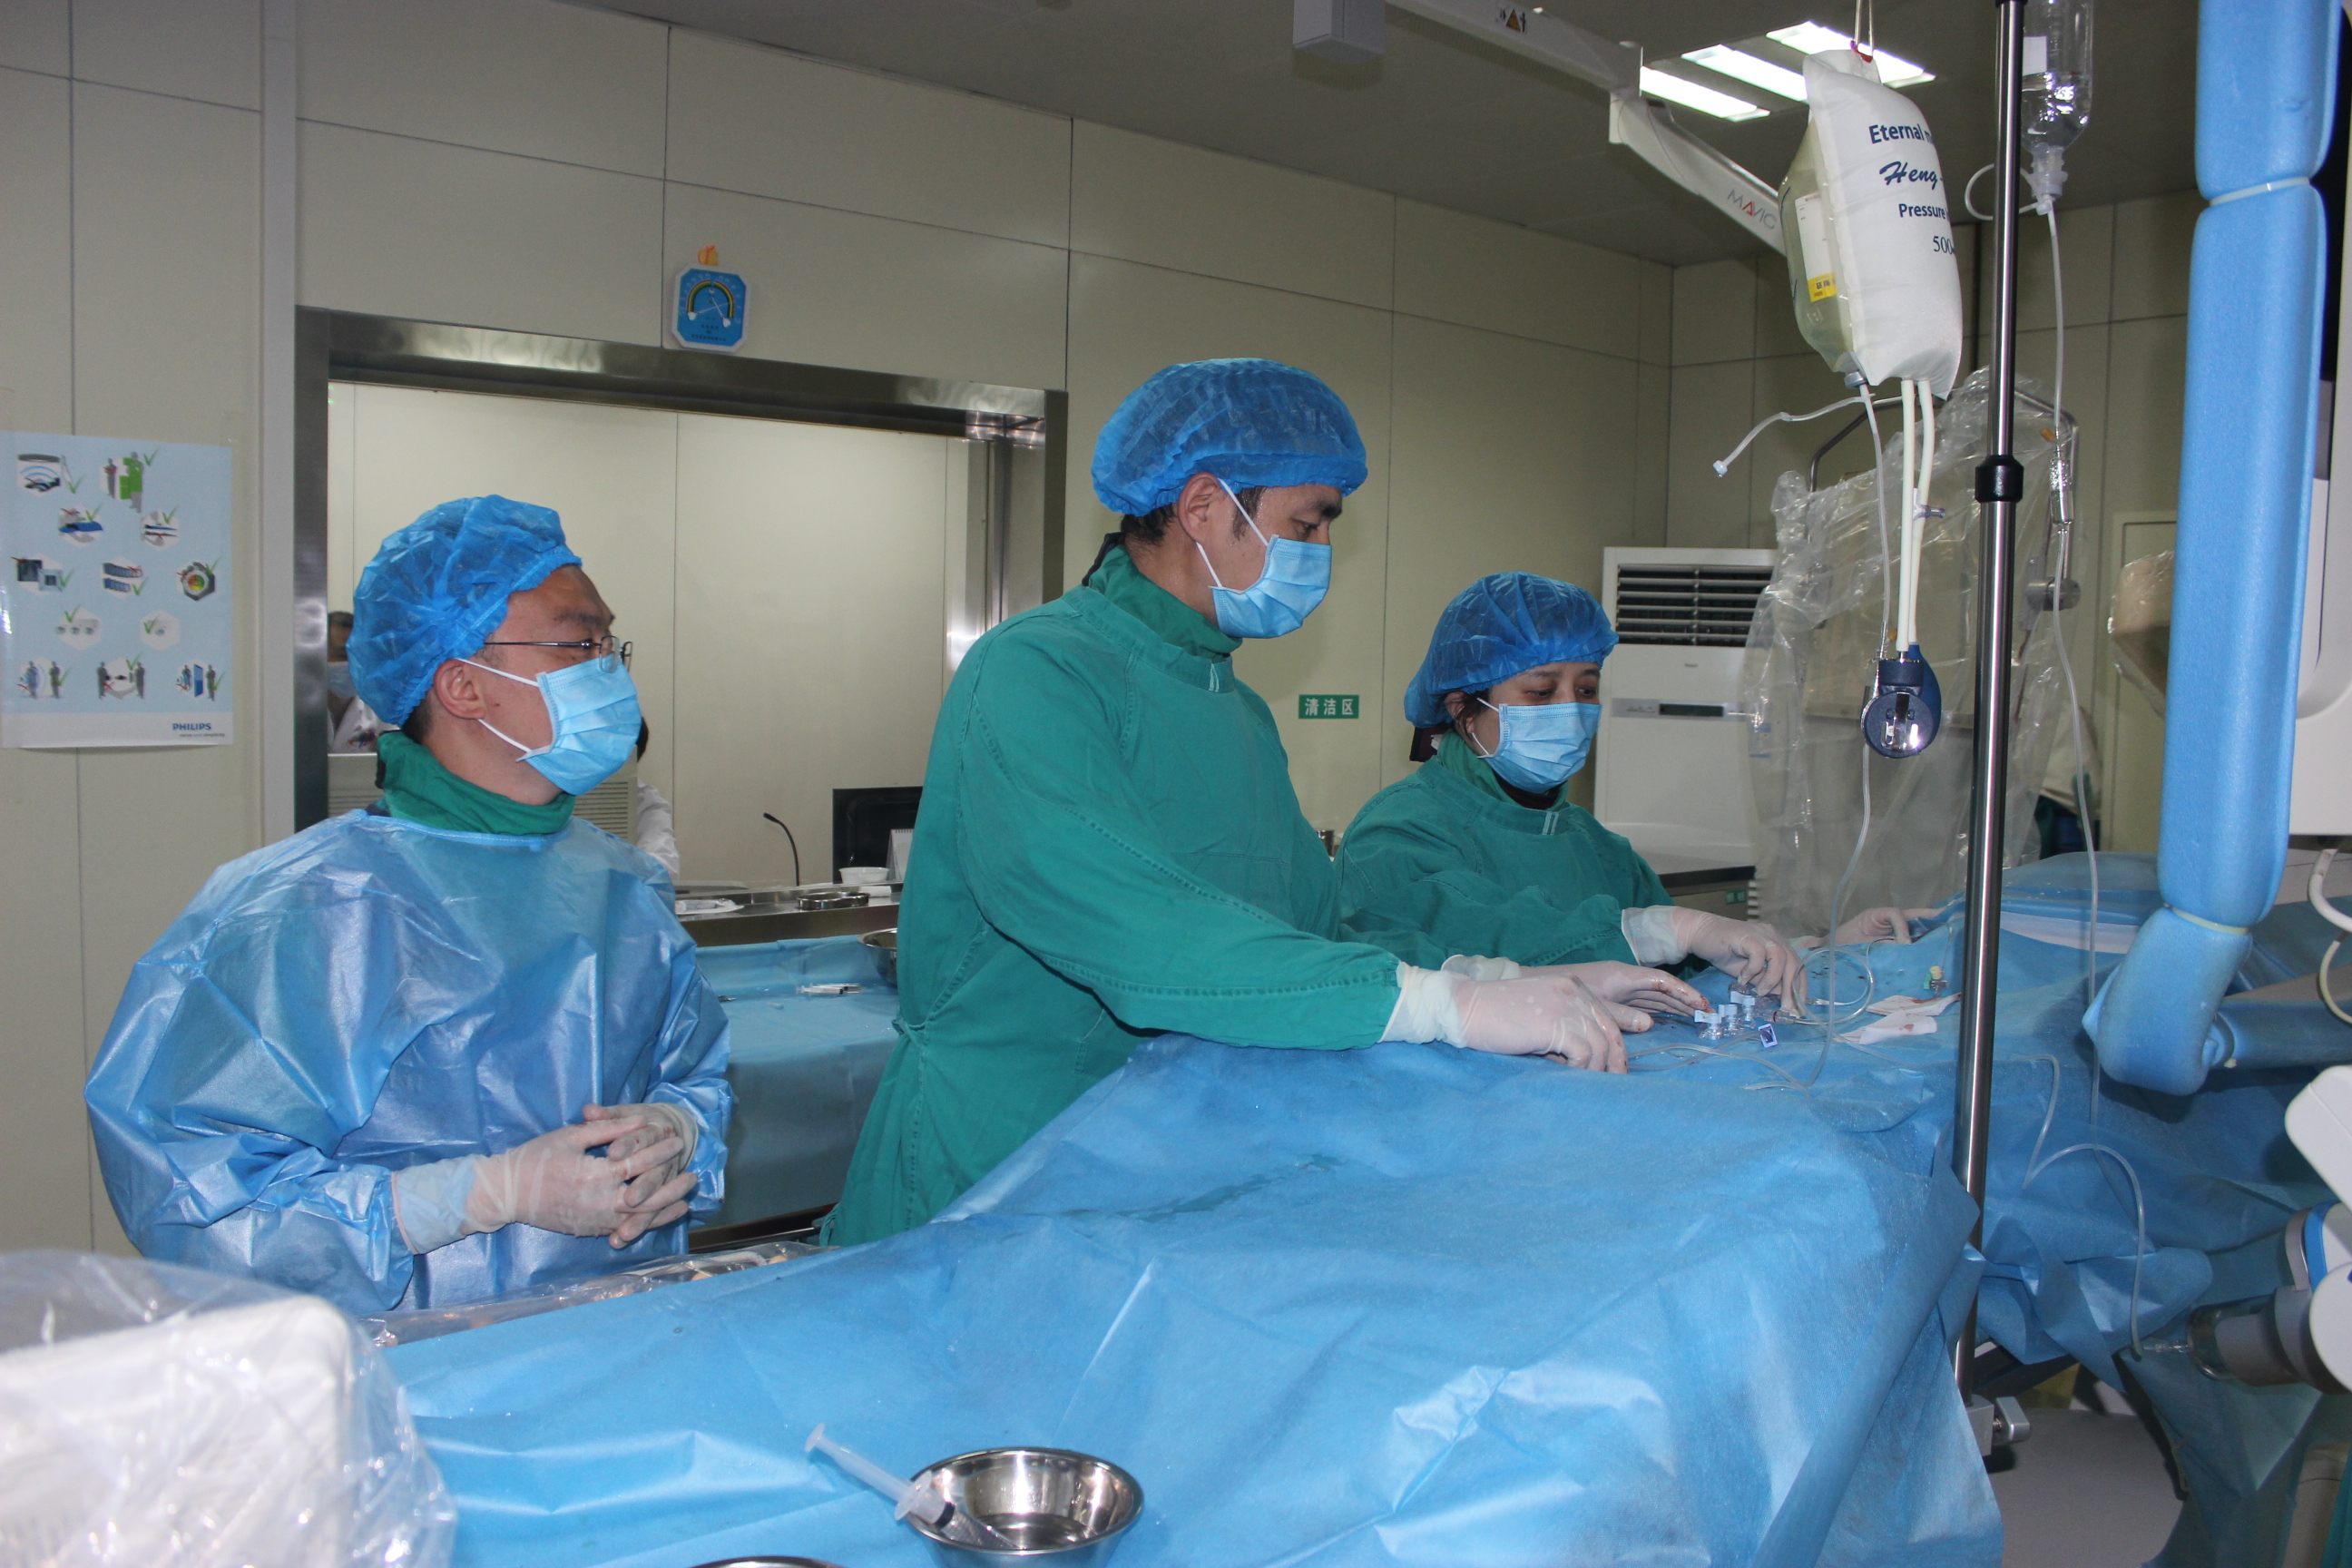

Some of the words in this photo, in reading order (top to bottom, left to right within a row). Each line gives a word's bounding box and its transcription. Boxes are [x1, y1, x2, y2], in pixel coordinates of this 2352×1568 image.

[1869, 123, 1925, 144] Eternal
[1898, 203, 1946, 220] Pressure
[1933, 235, 1955, 255] 500
[1305, 698, 1354, 716] 清洁区
[172, 722, 211, 730] PHILIPS
